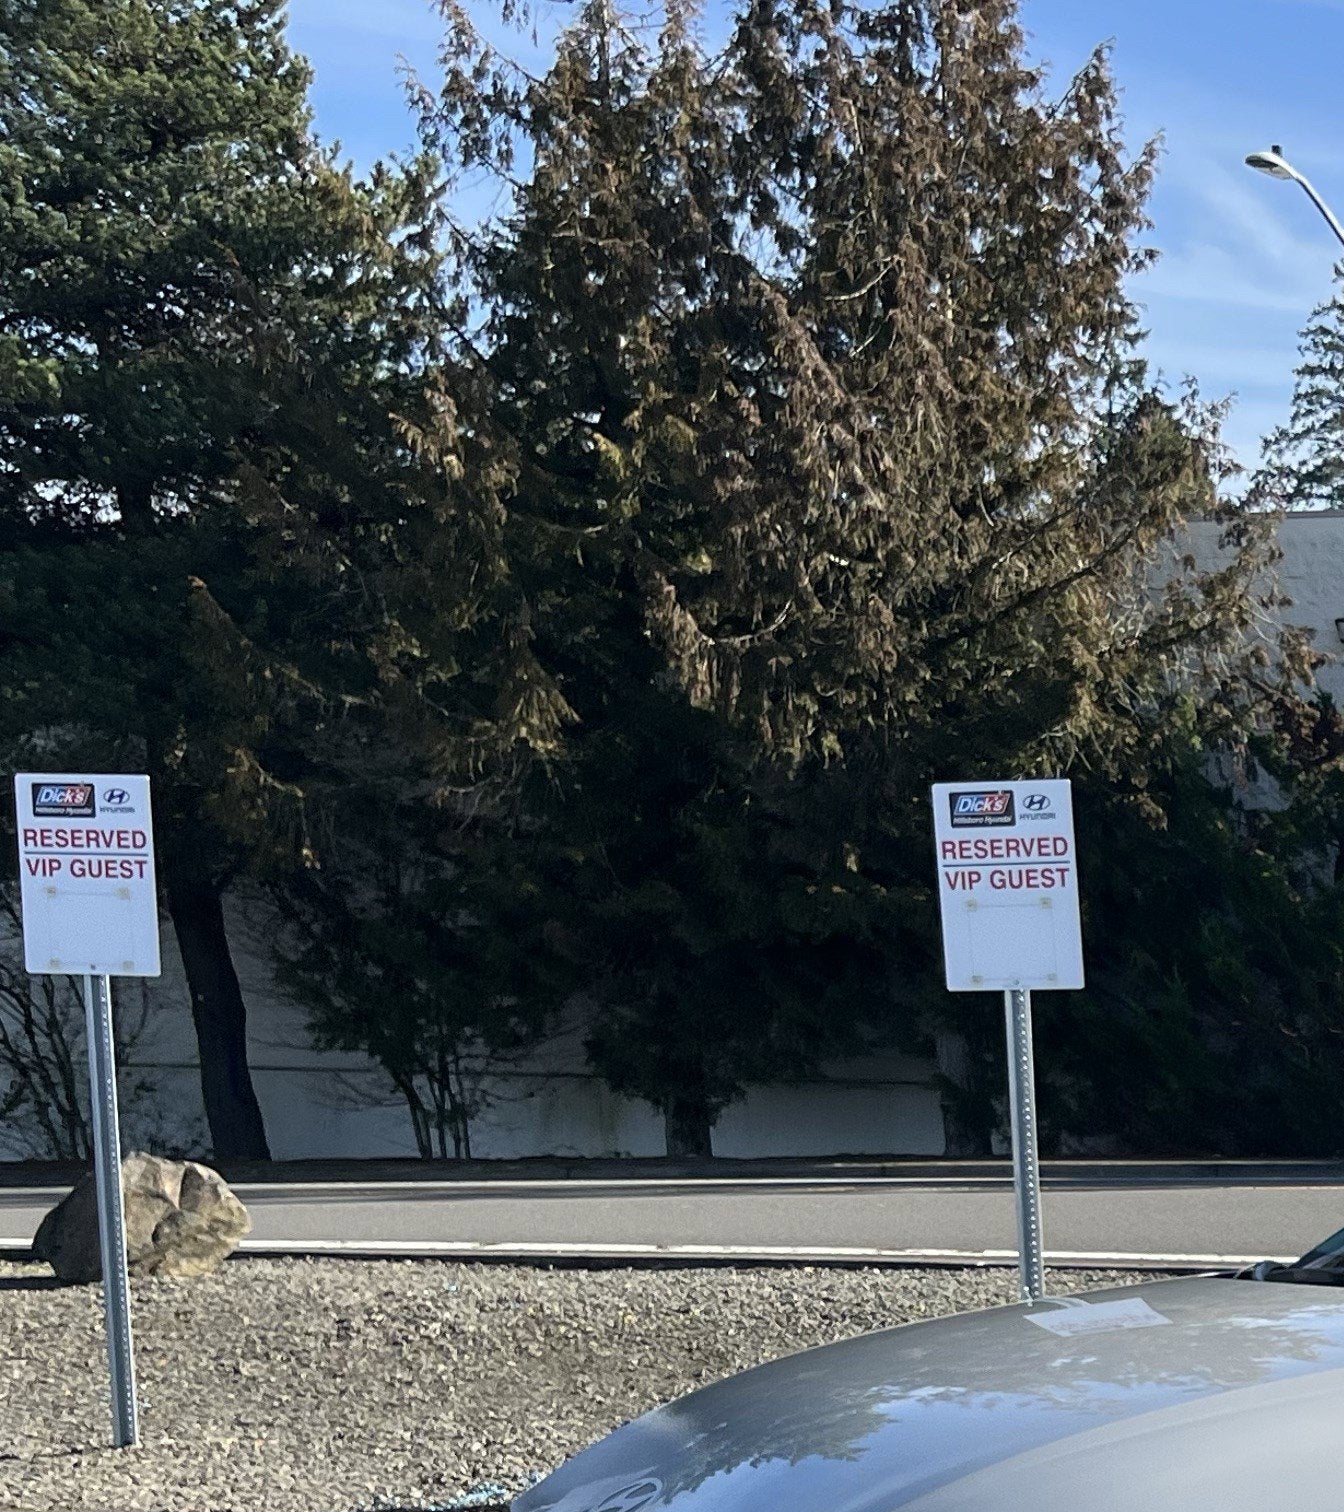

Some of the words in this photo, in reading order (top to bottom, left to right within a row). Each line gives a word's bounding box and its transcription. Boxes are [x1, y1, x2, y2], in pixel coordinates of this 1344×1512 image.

[39, 786, 85, 804] Dick's
[958, 795, 1005, 813] Dick's
[23, 828, 147, 849] RESERVED
[941, 836, 1069, 860] RESERVED
[25, 858, 62, 877] VIP
[70, 859, 148, 879] GUEST
[944, 870, 981, 890] VIP
[989, 867, 1070, 890] GUEST
